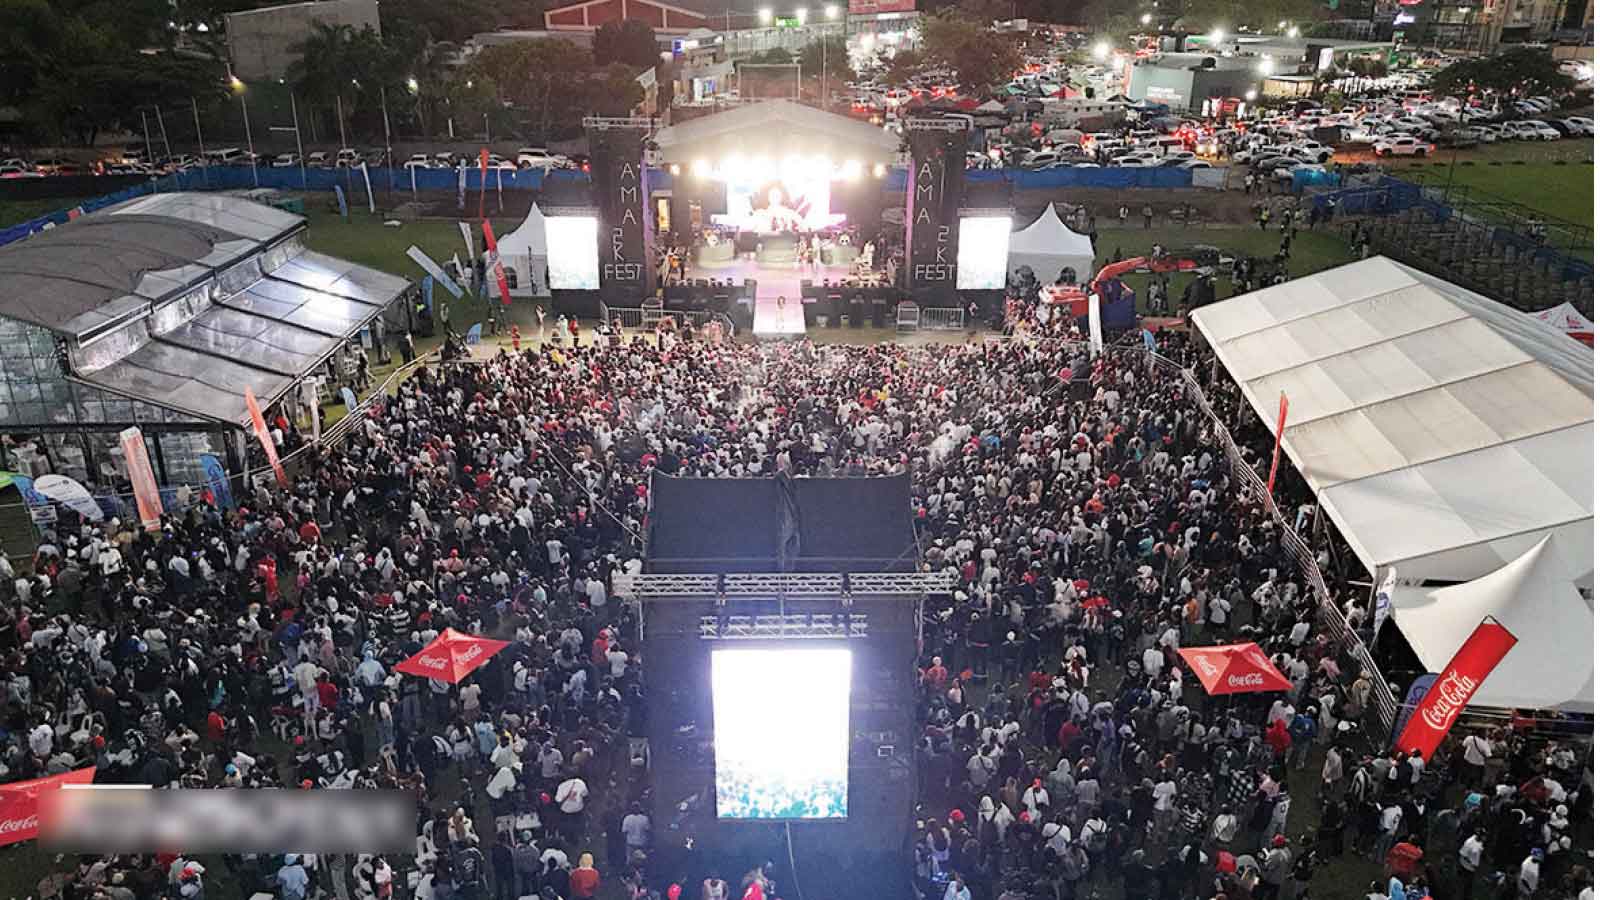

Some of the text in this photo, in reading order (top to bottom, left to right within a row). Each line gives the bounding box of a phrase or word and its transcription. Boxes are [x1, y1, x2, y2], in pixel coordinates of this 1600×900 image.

[619, 162, 637, 224] AMA
[914, 162, 955, 280] AMA 2K FEST
[604, 264, 643, 280] FEST
